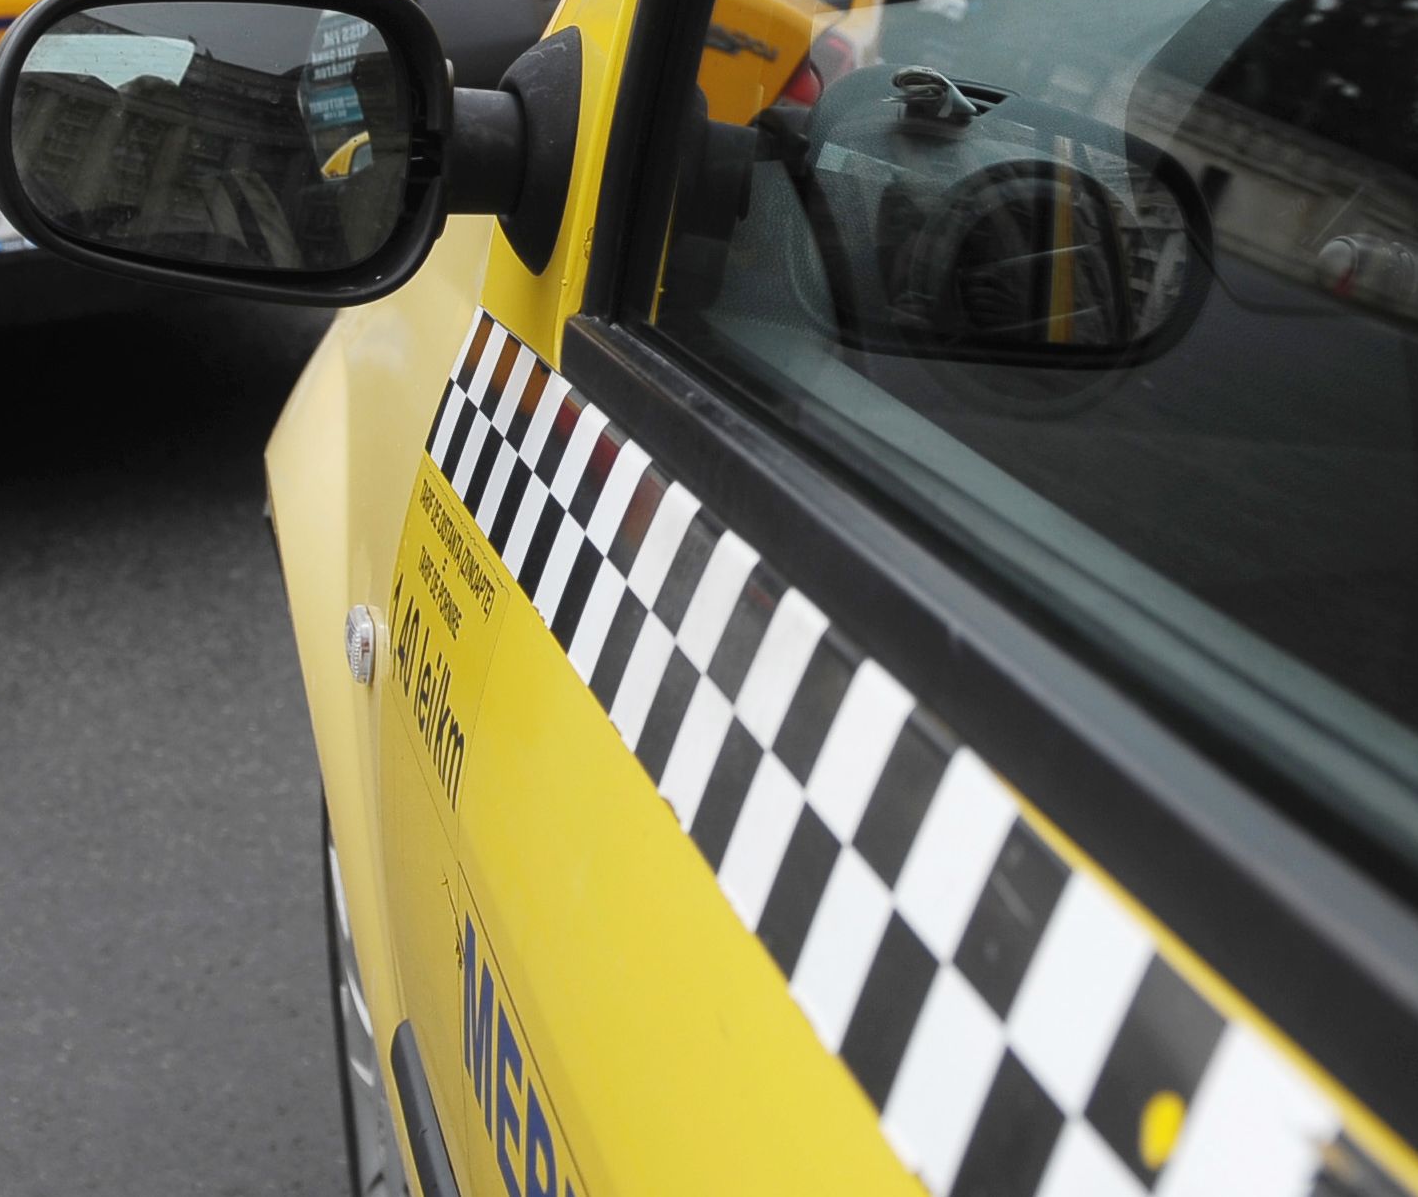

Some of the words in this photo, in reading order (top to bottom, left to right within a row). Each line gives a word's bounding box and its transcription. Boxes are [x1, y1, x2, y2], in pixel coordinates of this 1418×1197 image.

[390, 573, 420, 696] 1,40
[413, 626, 465, 813] lei/km
[464, 909, 577, 1197] MER
